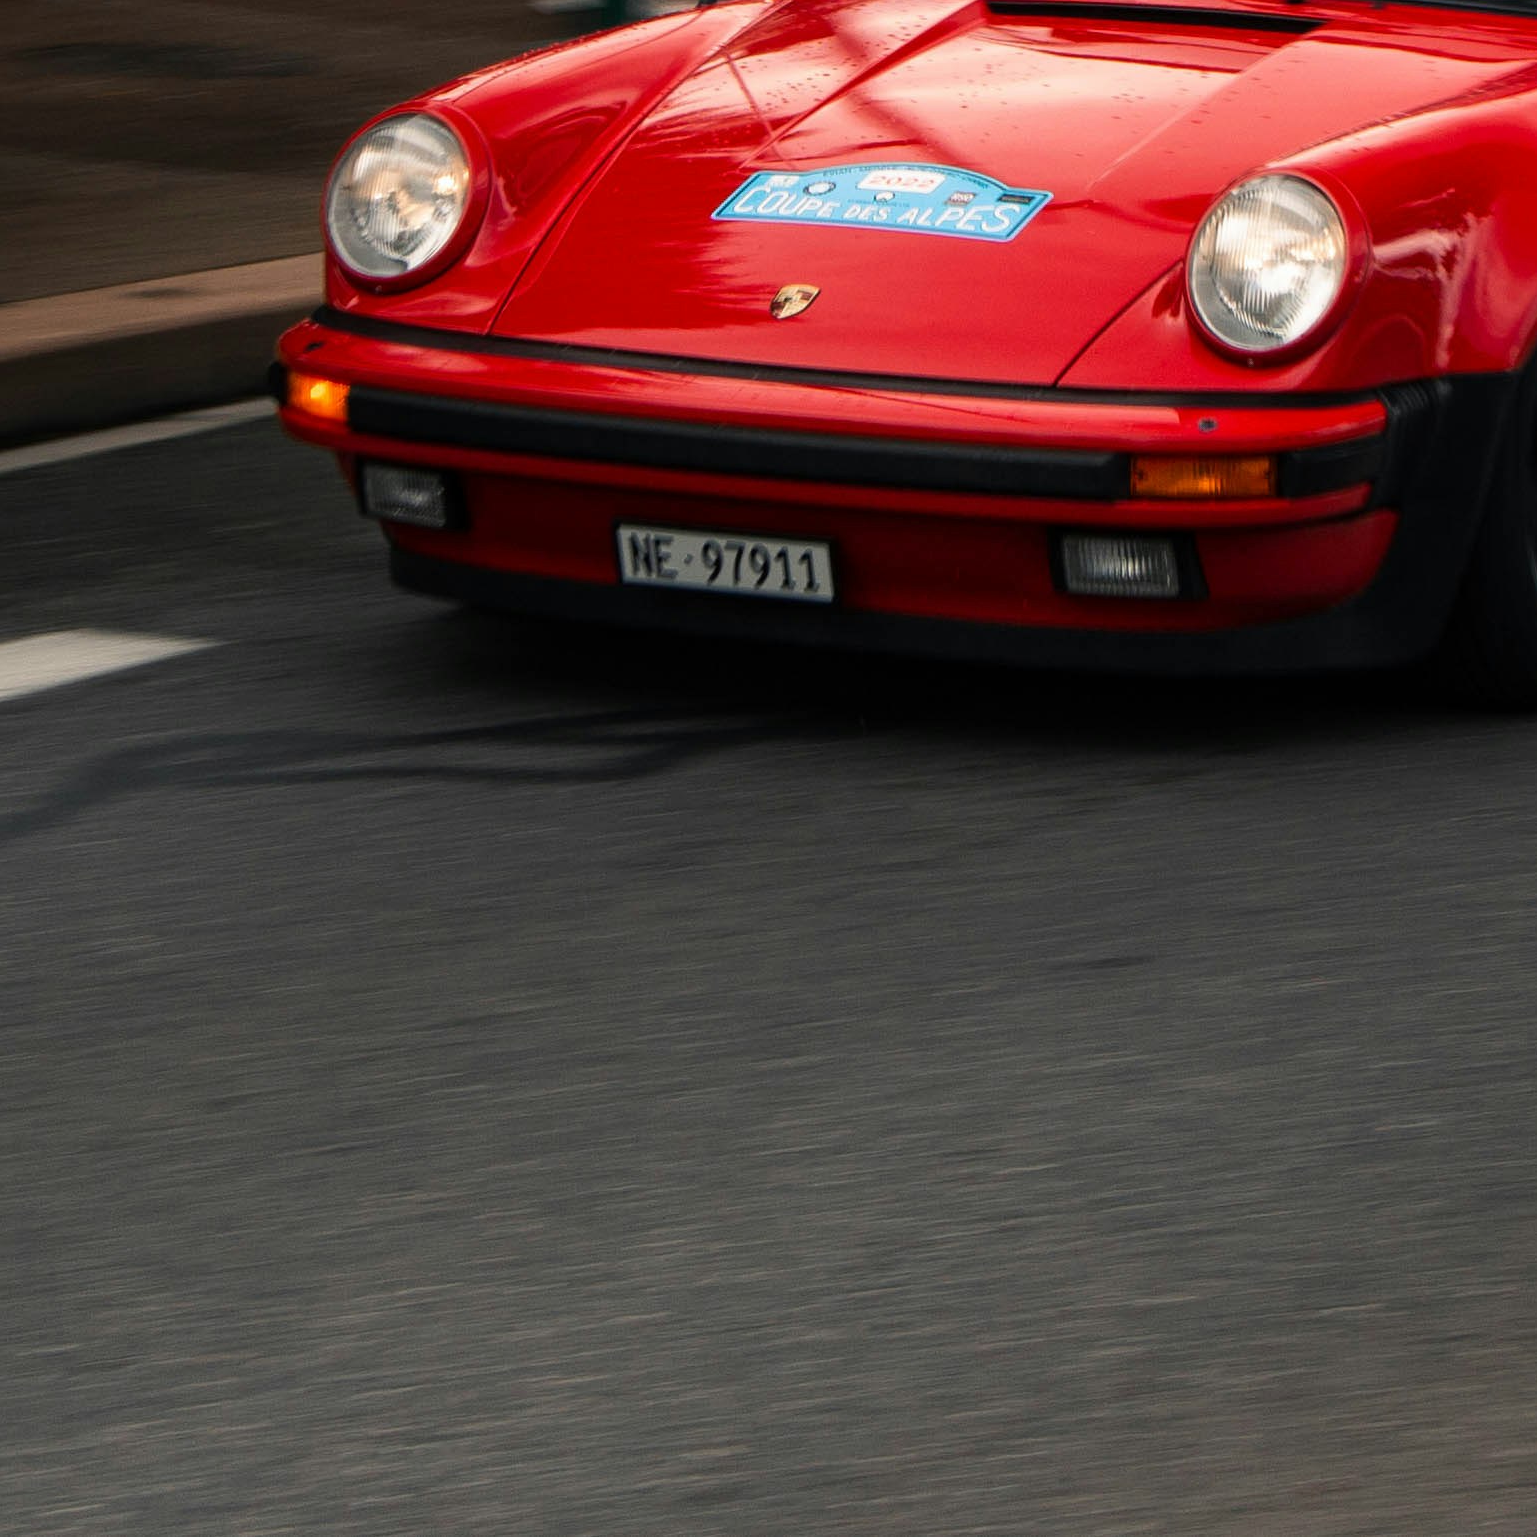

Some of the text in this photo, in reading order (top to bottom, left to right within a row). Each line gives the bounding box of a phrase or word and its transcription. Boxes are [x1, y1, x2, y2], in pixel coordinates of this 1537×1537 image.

[867, 174, 939, 189] 2022
[733, 185, 1021, 233] COUPE DES ALPES
[629, 531, 821, 594] NE 97911
